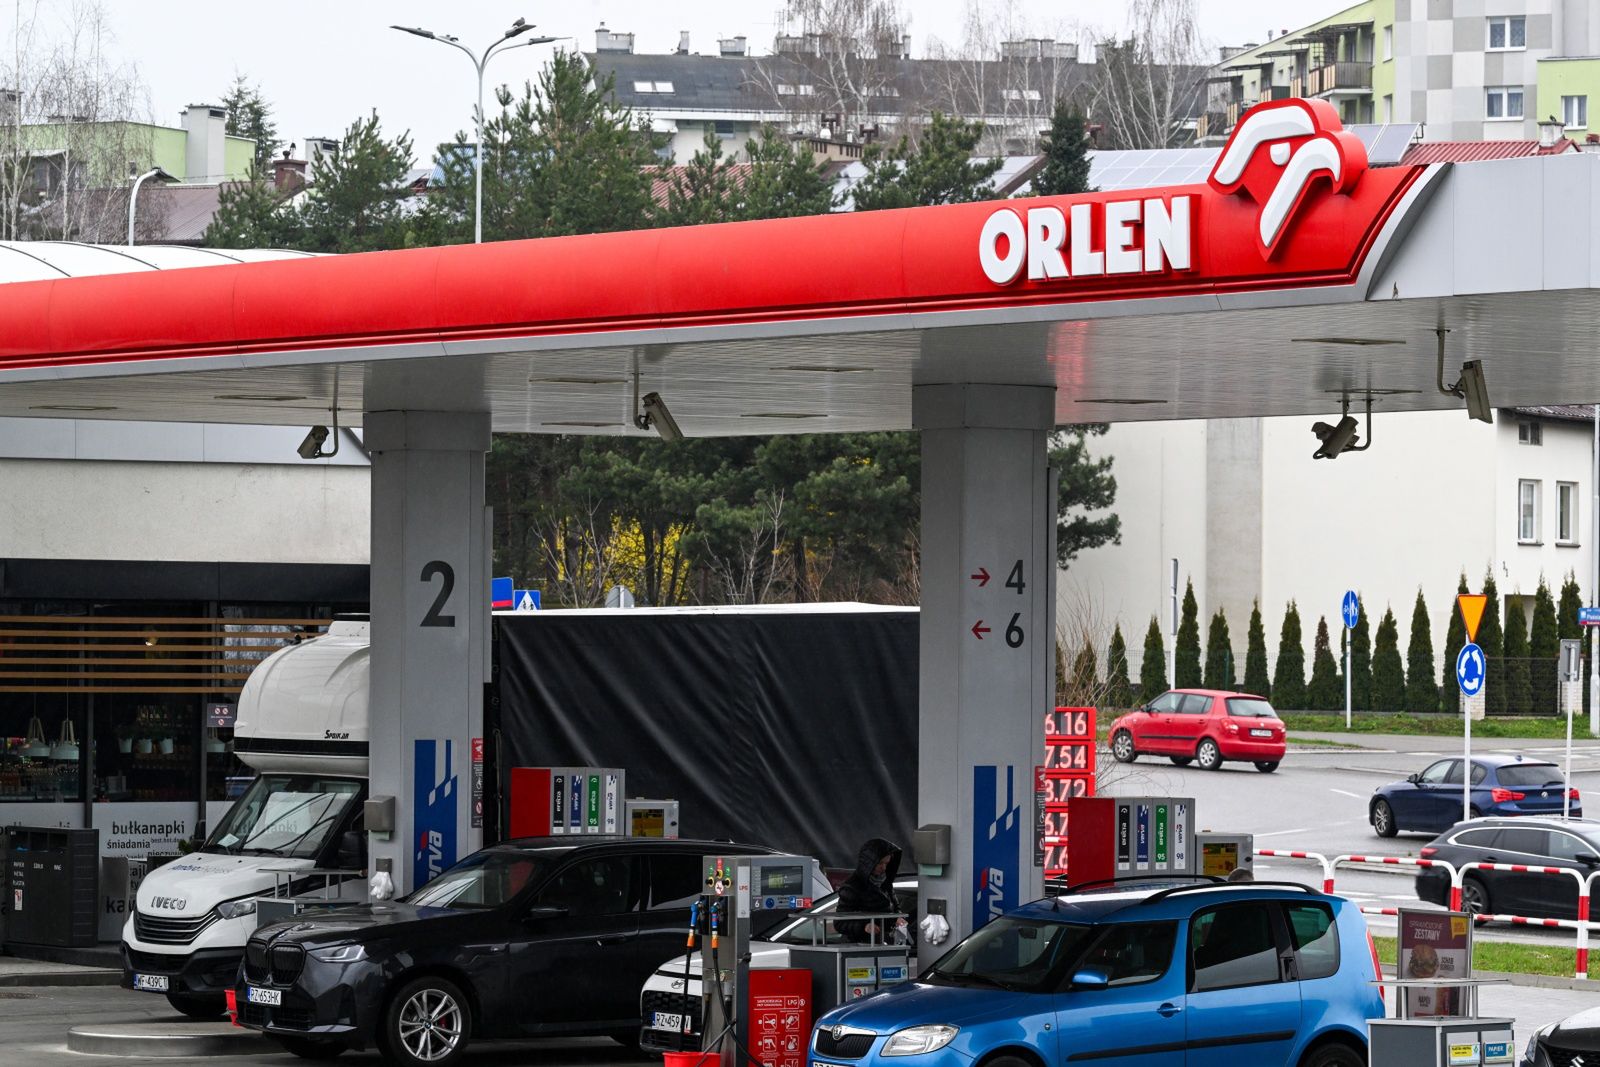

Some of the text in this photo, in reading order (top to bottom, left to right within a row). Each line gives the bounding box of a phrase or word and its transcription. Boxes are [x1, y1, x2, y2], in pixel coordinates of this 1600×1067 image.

[979, 195, 1192, 286] ORLEN
[1005, 560, 1025, 595] 4
[420, 560, 455, 627] 2
[1005, 613, 1024, 648] 6
[1045, 712, 1087, 735] 6.16
[1045, 745, 1086, 769] 7.54
[112, 820, 185, 837] bułkanapki
[1045, 812, 1068, 835] 6.7
[107, 838, 151, 849] śniadania
[1044, 846, 1068, 869] 7.6
[151, 896, 186, 910] IVECO
[754, 899, 760, 908] 6
[1414, 929, 1441, 941] ZESTAWY
